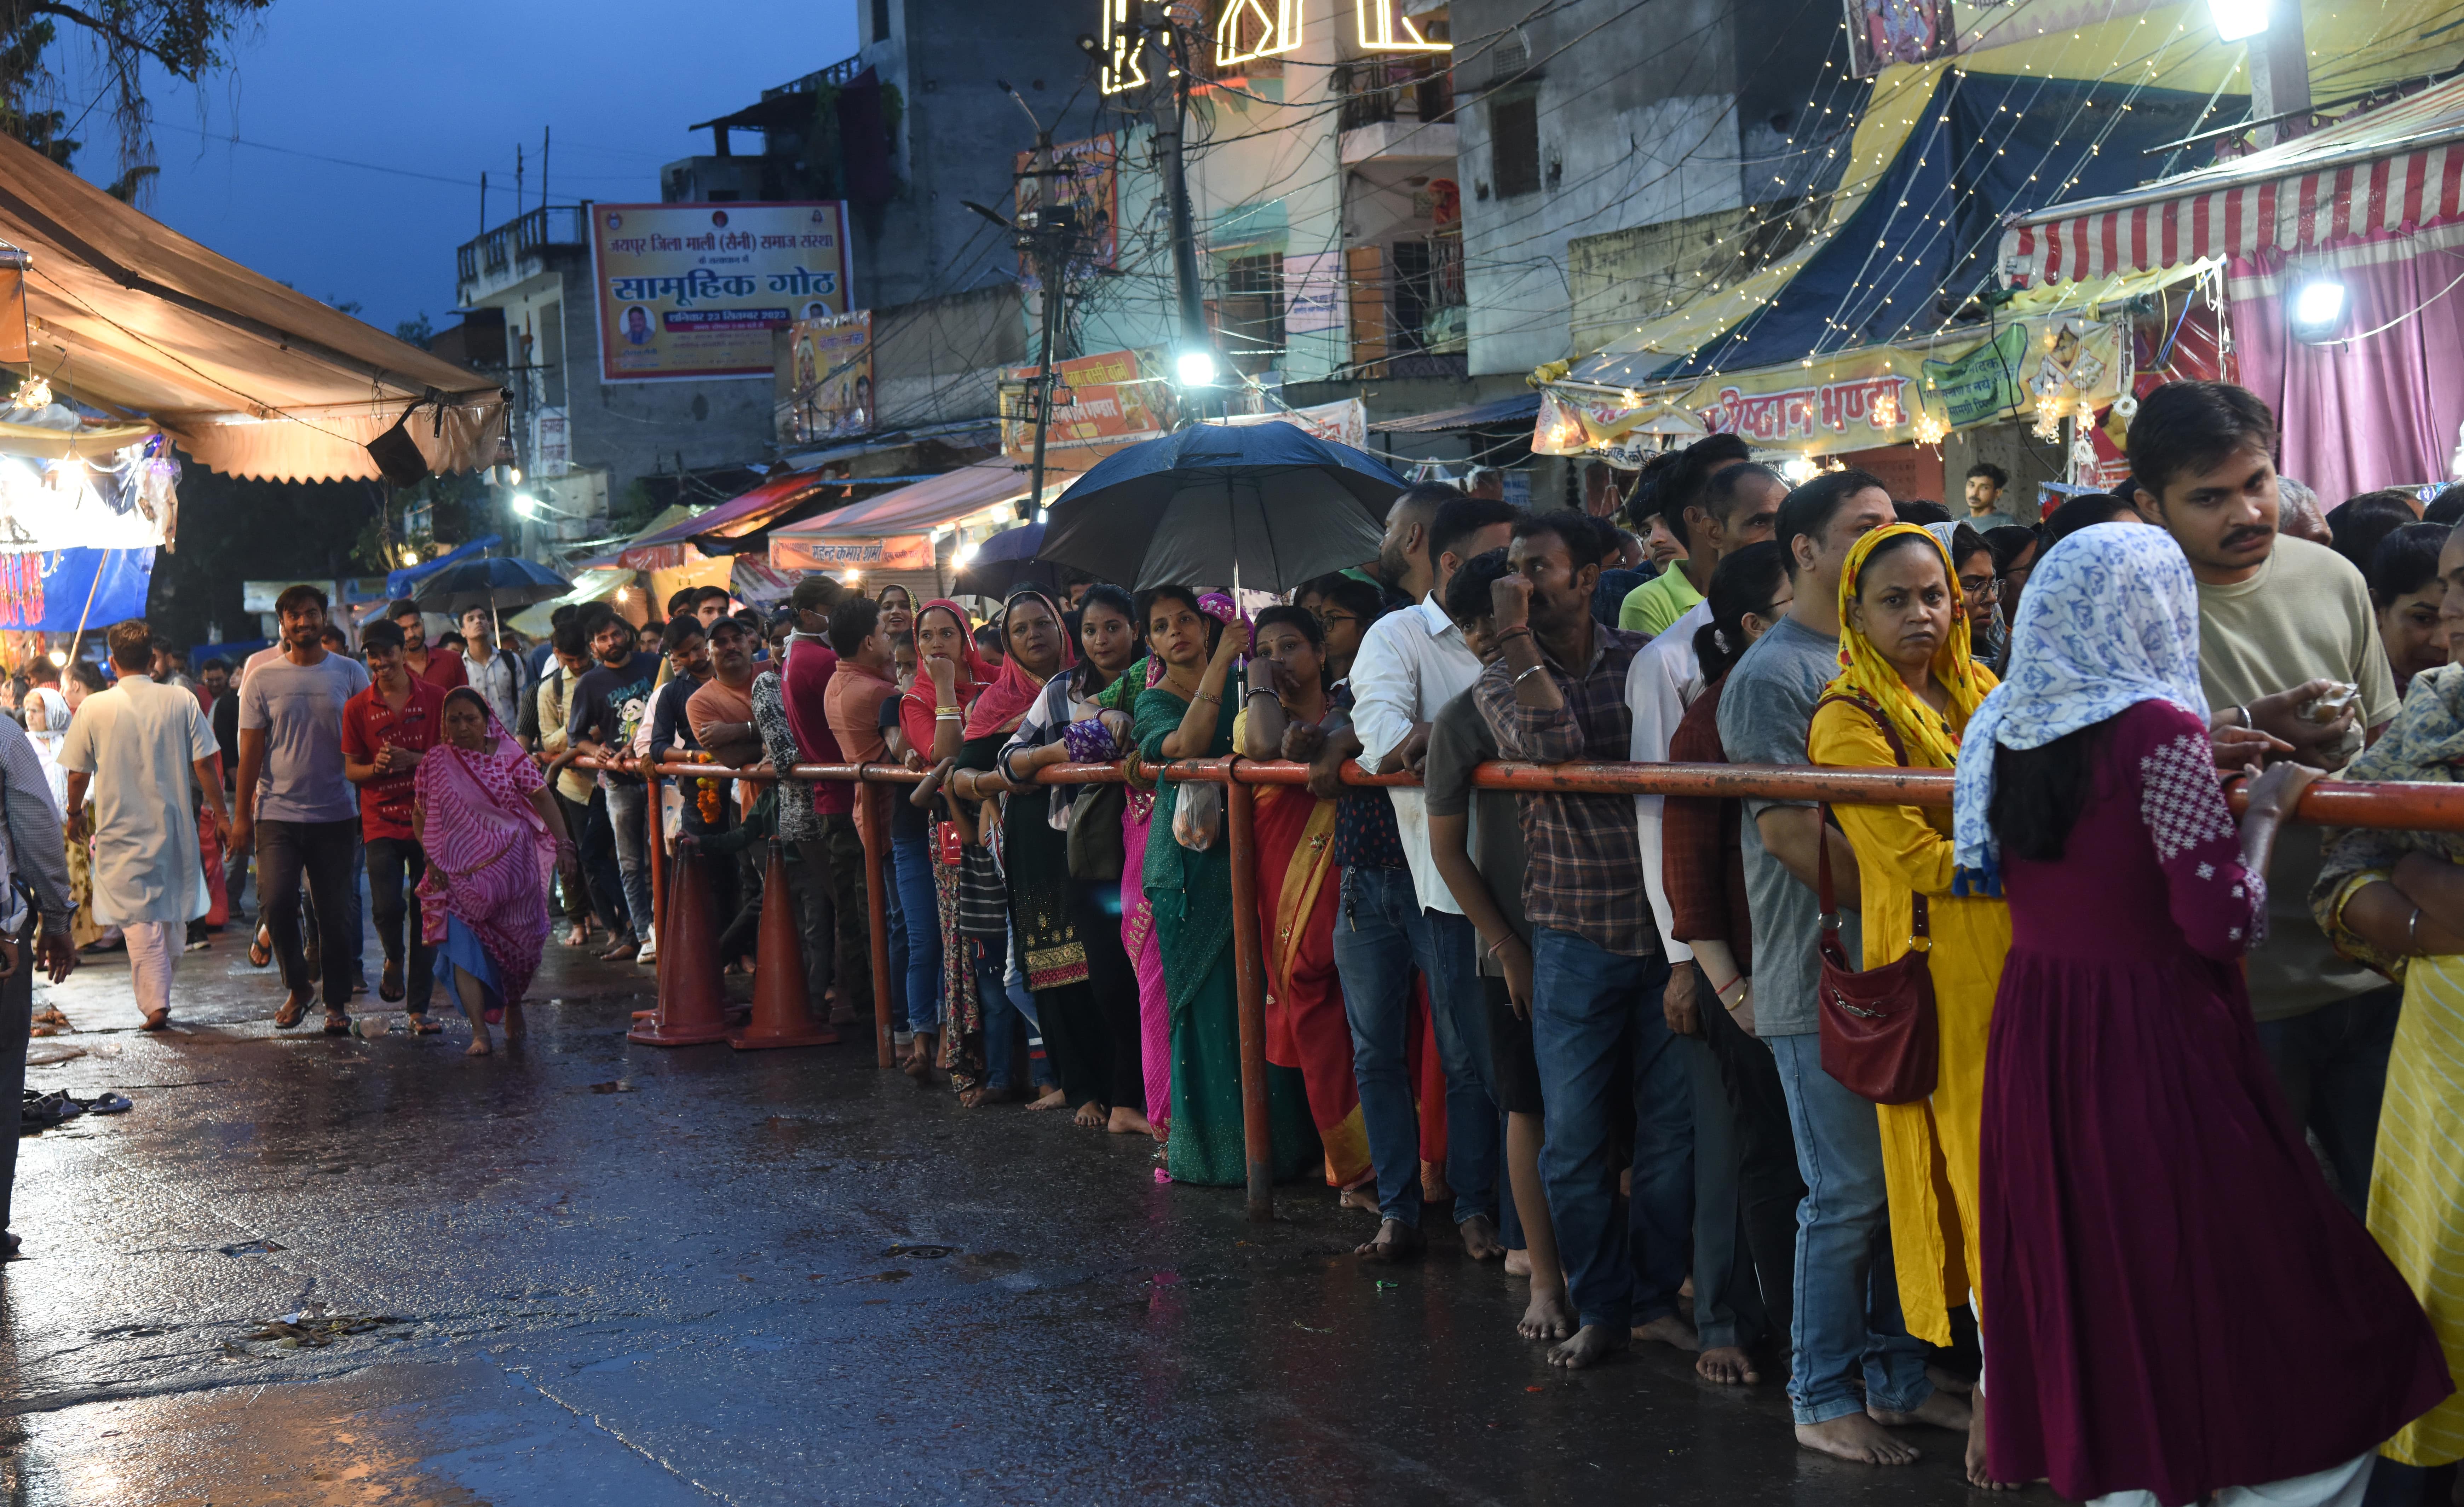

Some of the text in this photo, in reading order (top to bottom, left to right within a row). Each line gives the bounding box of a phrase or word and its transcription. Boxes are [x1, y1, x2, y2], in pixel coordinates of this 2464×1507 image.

[609, 238, 646, 257] जयपुर
[650, 233, 682, 252] जिला
[686, 231, 715, 251] माली
[720, 231, 757, 252] (सैनी)
[761, 235, 796, 249] समाज
[610, 266, 836, 307] सामूहिक गोठ
[761, 310, 787, 319] 2023
